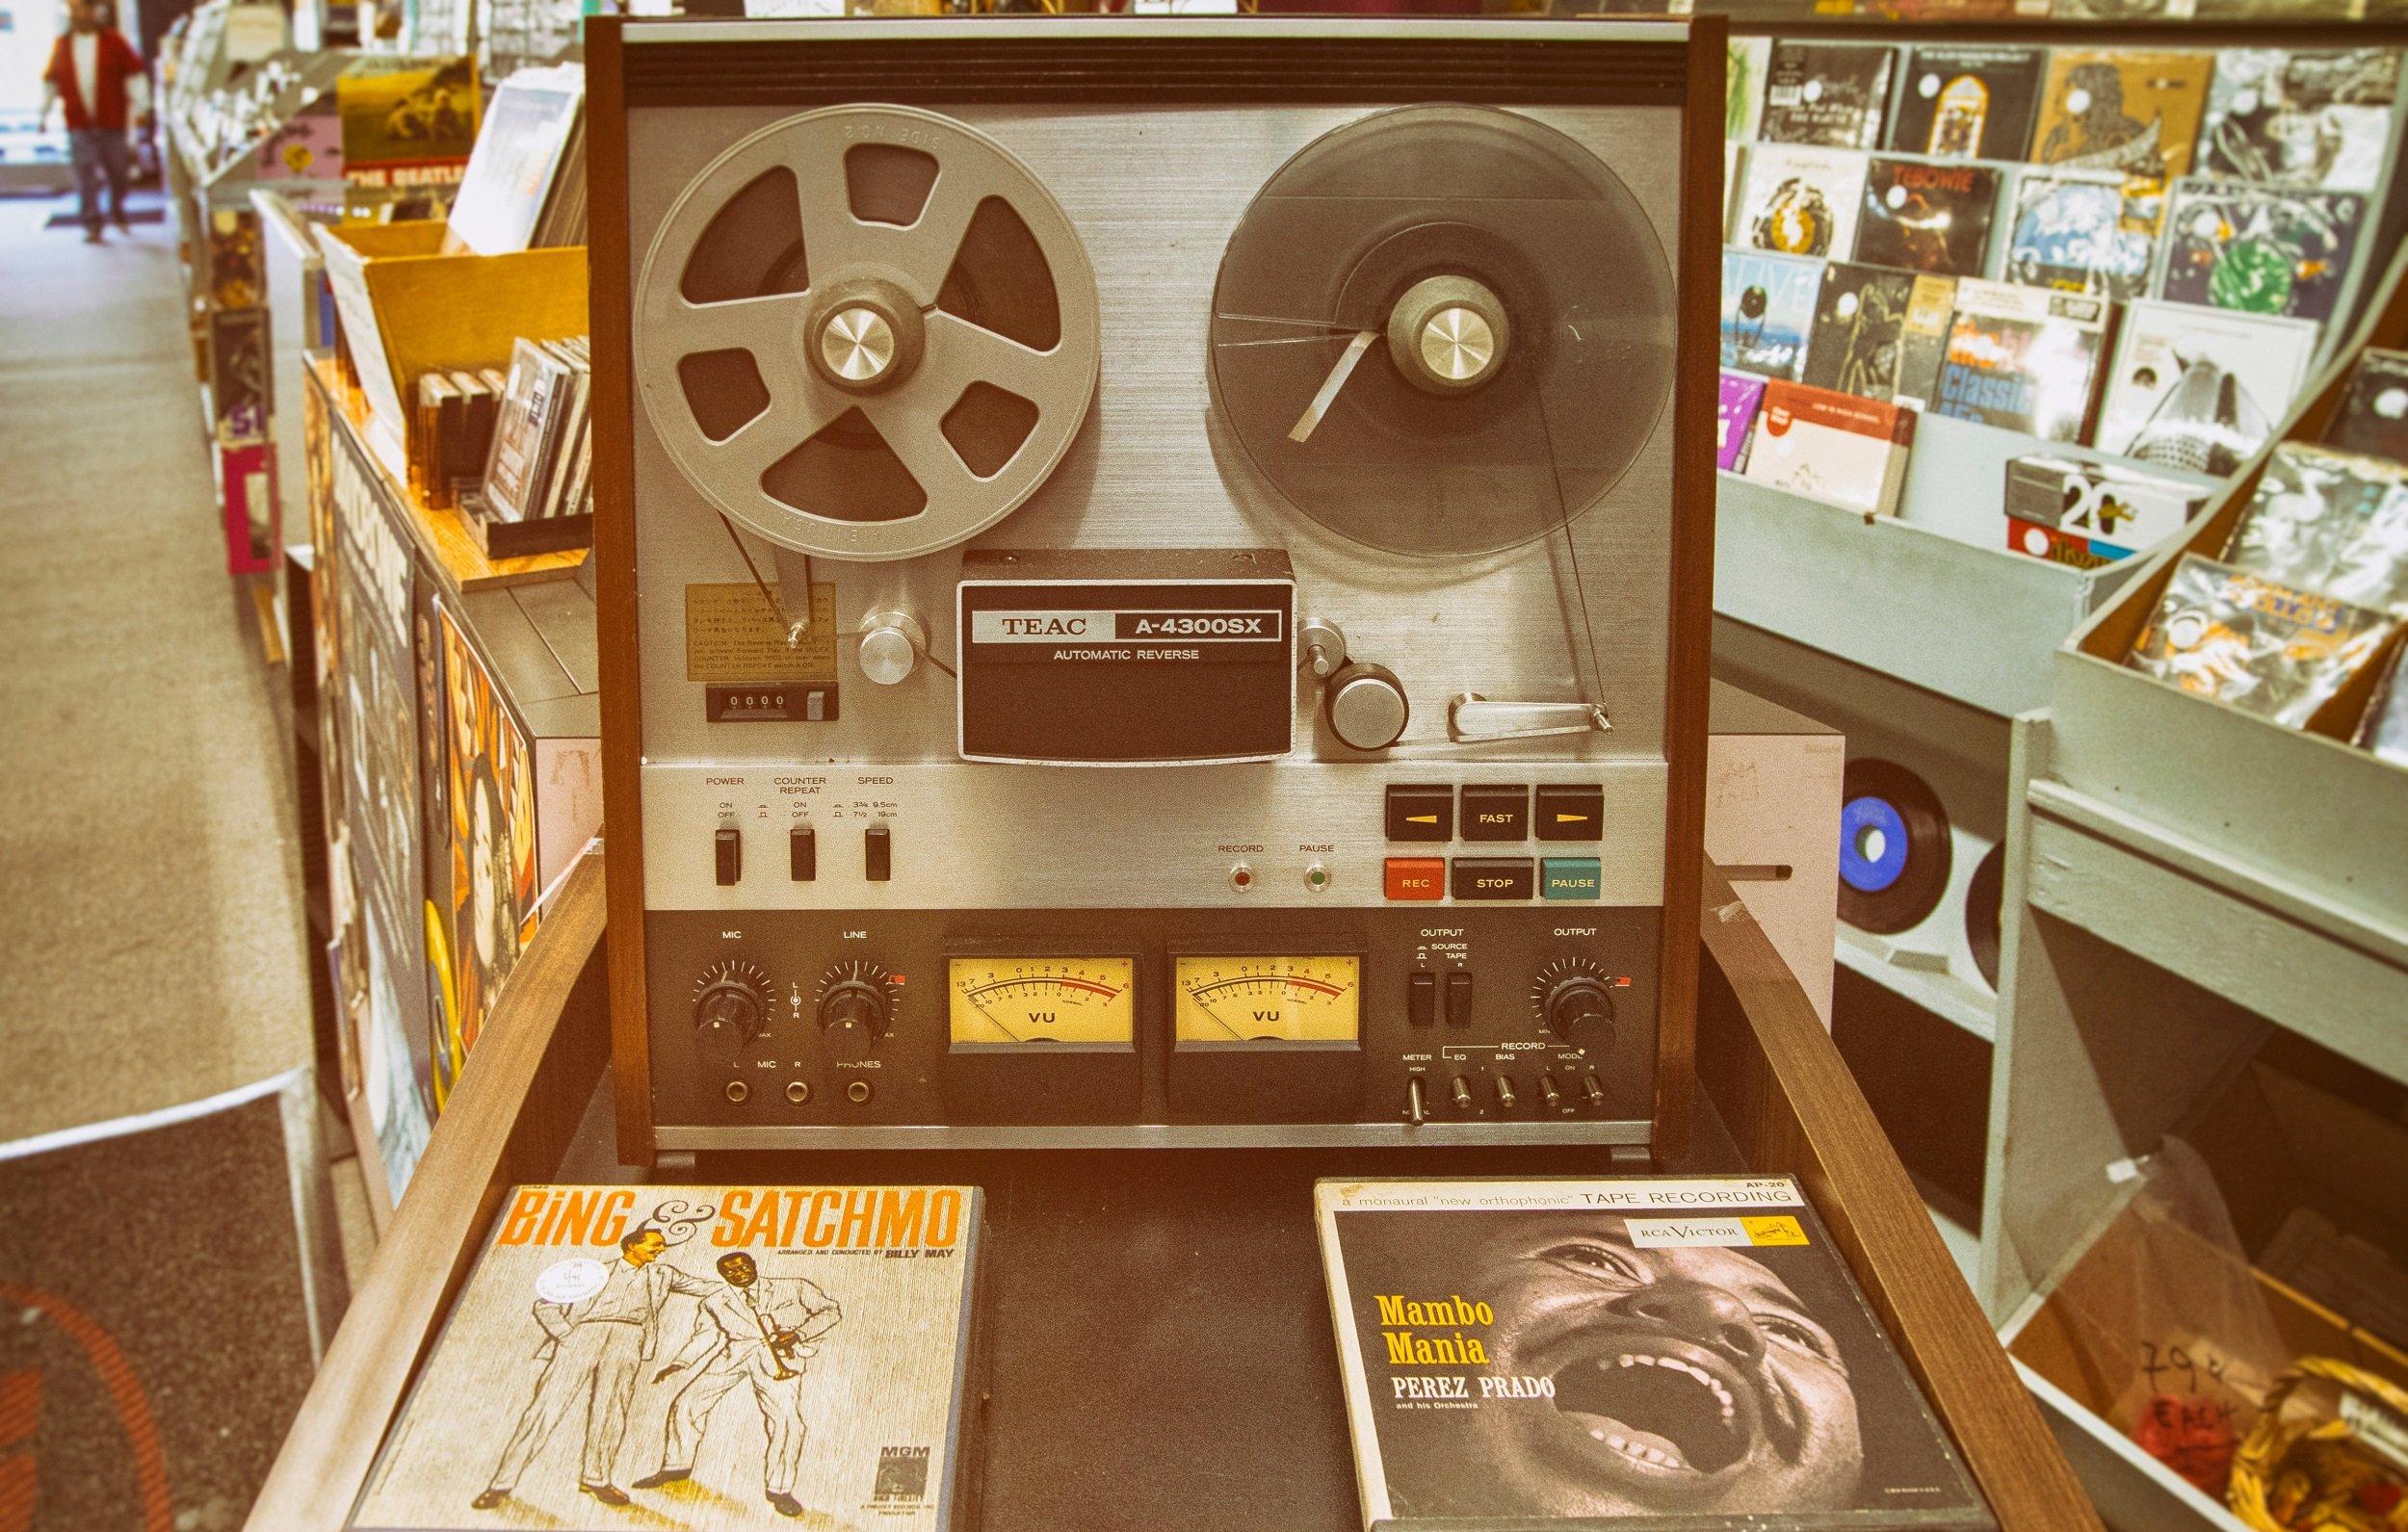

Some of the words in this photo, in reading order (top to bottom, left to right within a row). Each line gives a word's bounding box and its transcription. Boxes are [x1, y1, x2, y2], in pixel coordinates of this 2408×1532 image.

[1002, 618, 1086, 636] TEAC
[1136, 618, 1263, 635] A-4300SX
[1054, 650, 1131, 661] AUTOMATIC
[1137, 650, 1200, 660] REVERSE
[705, 777, 745, 786] POWER
[773, 777, 826, 786] COUNTER
[857, 776, 894, 785] SPEED
[1479, 814, 1514, 824] FAST
[1217, 844, 1264, 853] RECORD
[1298, 844, 1335, 853] PAUSE
[1401, 878, 1430, 889] REC
[1476, 878, 1514, 889] STOP
[1551, 877, 1596, 889] PAUSE
[843, 930, 868, 939] LINE
[1420, 928, 1464, 937] OUTPUT
[1028, 1012, 1056, 1023] VU
[1252, 1011, 1280, 1022] VU
[1501, 1042, 1546, 1051] RECORD
[1342, 1198, 1351, 1207] a
[1359, 1195, 1428, 1207] monaural
[1580, 1192, 1641, 1205] TAPE
[1648, 1190, 1793, 1205] RECORDING
[711, 1190, 961, 1248] SATCHMO
[885, 1249, 921, 1259] BILLY
[925, 1248, 955, 1259] MAY
[1374, 1295, 1495, 1326] Mambo
[1381, 1332, 1491, 1364] Mania
[1390, 1376, 1470, 1399] PEREZ
[1477, 1376, 1556, 1399] PRADO
[1396, 1401, 1414, 1410] and
[1417, 1401, 1431, 1410] his
[1433, 1401, 1479, 1410] Orchestra
[880, 1446, 931, 1457] MGM
